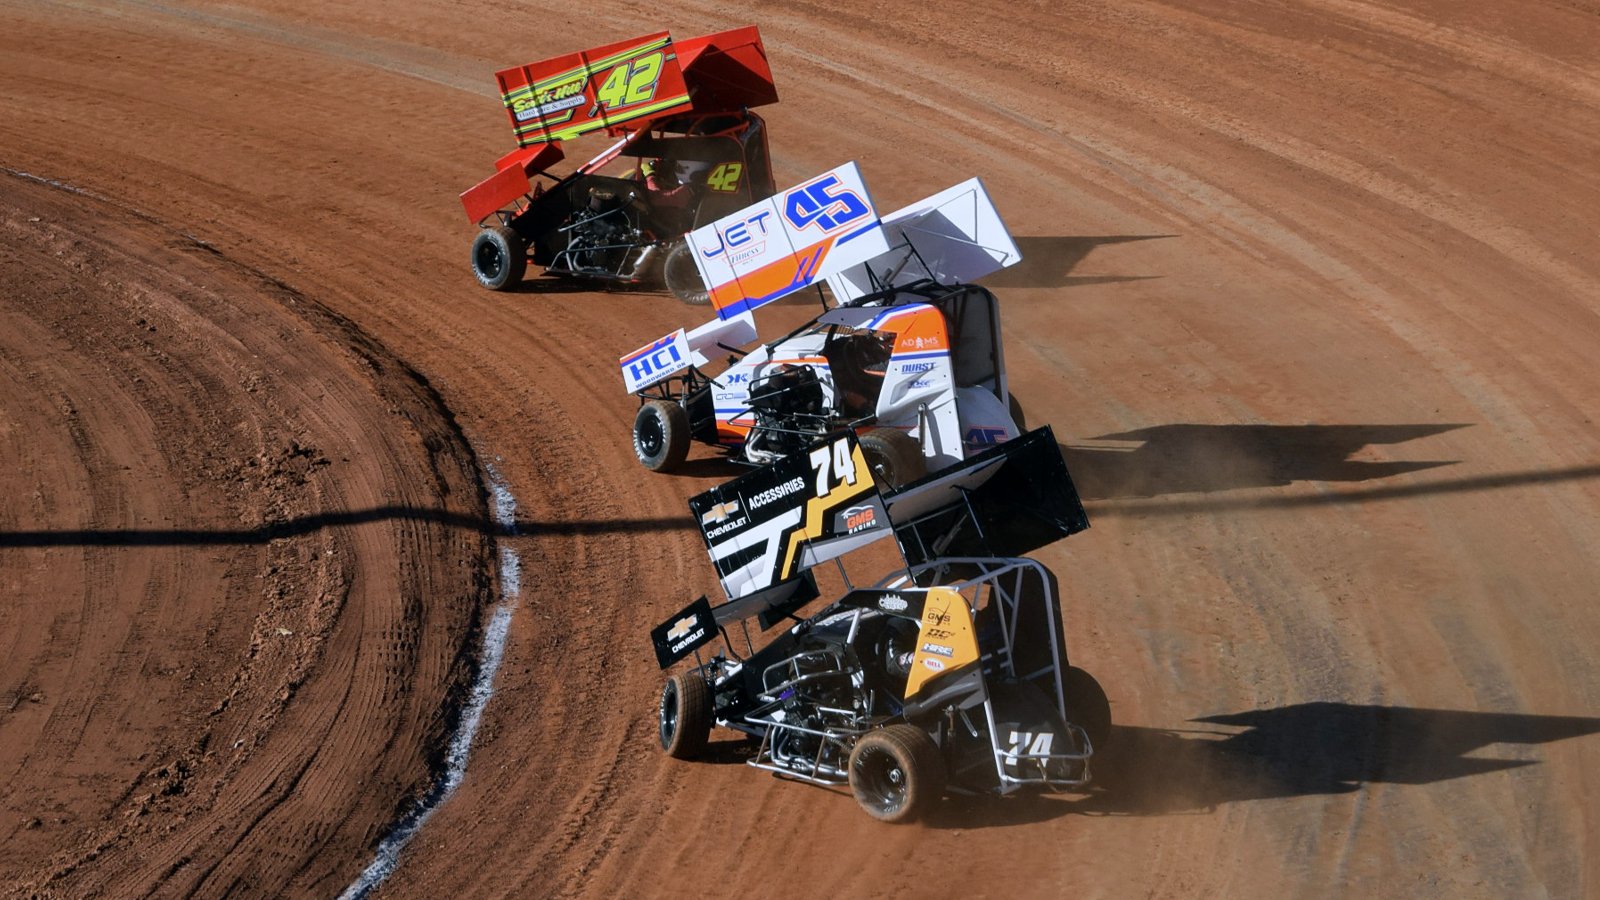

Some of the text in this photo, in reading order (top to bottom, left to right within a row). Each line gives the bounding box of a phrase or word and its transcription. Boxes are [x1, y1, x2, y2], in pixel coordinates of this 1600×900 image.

[553, 82, 581, 99] Hill
[598, 52, 656, 108] 42
[519, 105, 550, 118] Hardre
[560, 96, 583, 107] Supply
[707, 163, 742, 191] 42
[785, 175, 869, 231] 45
[703, 211, 770, 258] JET
[630, 344, 681, 382] HCI
[901, 362, 936, 373] DURST
[809, 437, 856, 497] 74
[847, 508, 874, 529] GMS
[848, 519, 876, 535] RACING
[671, 627, 705, 654] CHEVROLET
[1005, 731, 1054, 767] 74
